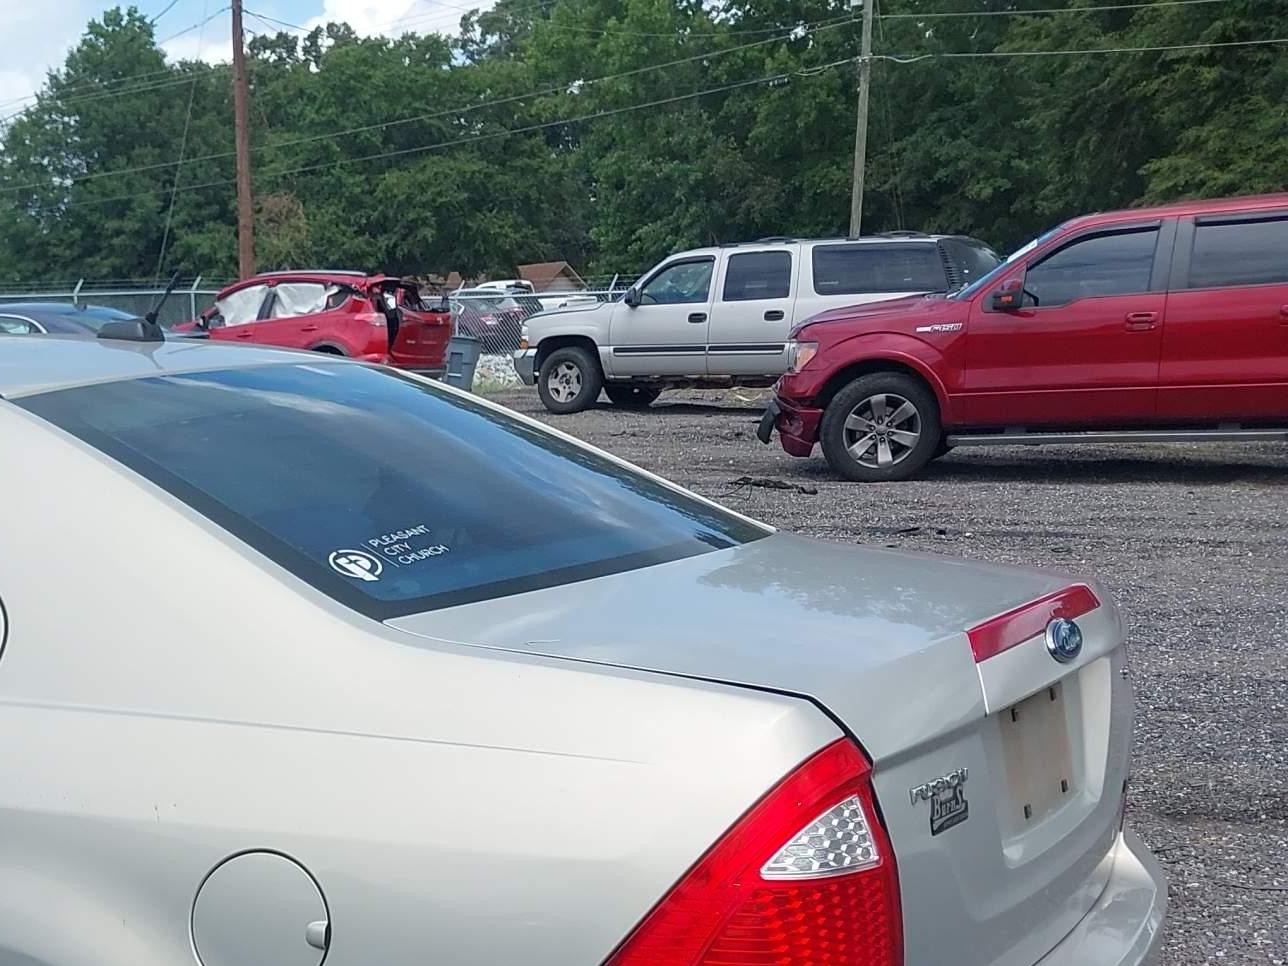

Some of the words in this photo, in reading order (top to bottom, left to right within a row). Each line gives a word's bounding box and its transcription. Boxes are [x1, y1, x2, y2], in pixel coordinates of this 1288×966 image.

[368, 524, 430, 548] PLEASANT
[384, 542, 411, 556] CITY
[398, 544, 449, 565] CHURCH
